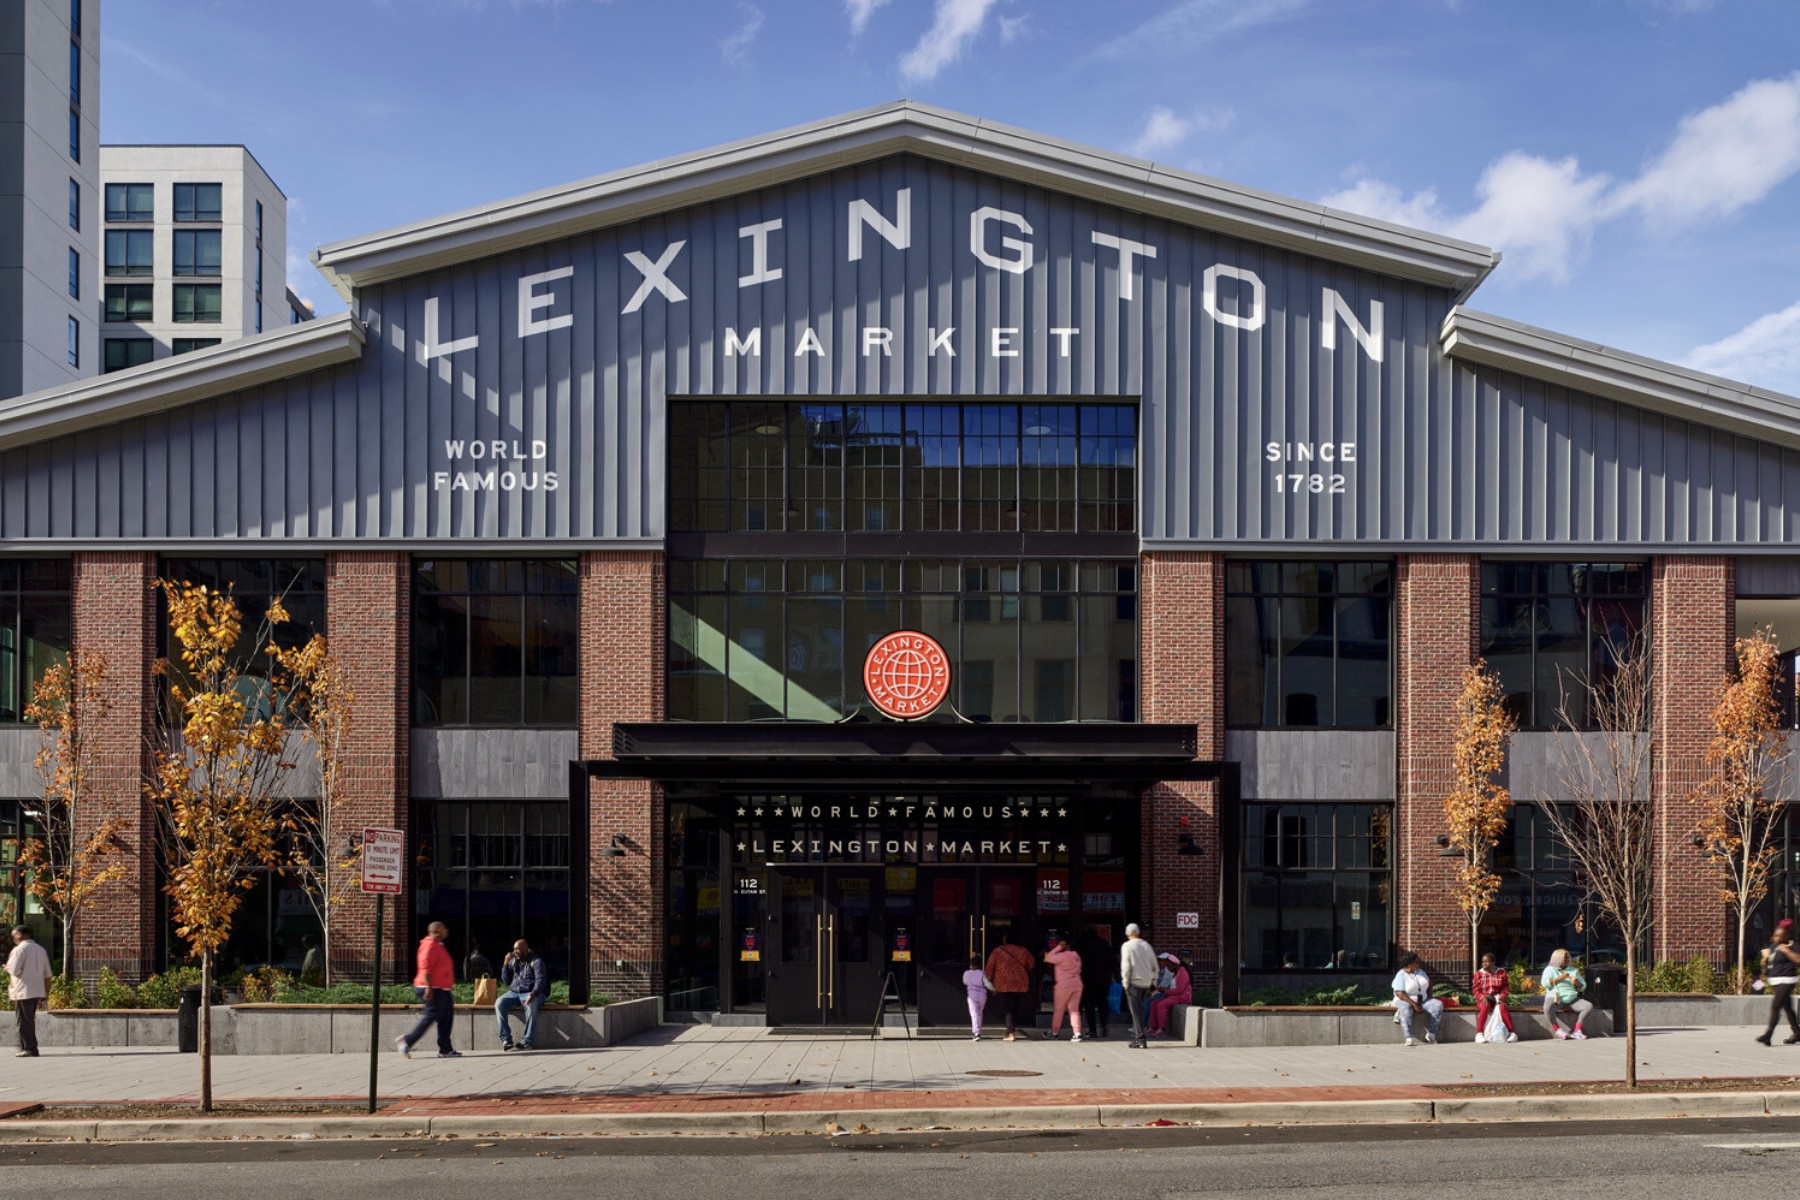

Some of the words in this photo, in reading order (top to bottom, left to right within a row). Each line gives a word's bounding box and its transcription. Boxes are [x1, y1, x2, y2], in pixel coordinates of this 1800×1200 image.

[424, 187, 1384, 363] LEXINGTON
[724, 326, 1080, 357] MARKET
[445, 439, 547, 460] WORLD
[1266, 441, 1356, 462] SINCE
[434, 471, 559, 491] FAMOUS
[1275, 473, 1346, 494] 1782
[870, 637, 944, 677] LEXINGTON
[874, 686, 939, 711] MARKET
[791, 806, 879, 818] WORLD
[906, 806, 1013, 818] FAMOUS
[366, 832, 374, 841] NO
[376, 833, 401, 843] PARKING
[373, 846, 389, 854] MINUTE
[753, 840, 918, 853] LEXINGTON
[942, 840, 1051, 853] MARKET
[370, 856, 395, 864] PASSENGER
[740, 878, 758, 889] 112
[1043, 879, 1061, 889] 112
[1177, 914, 1198, 925] FDC
